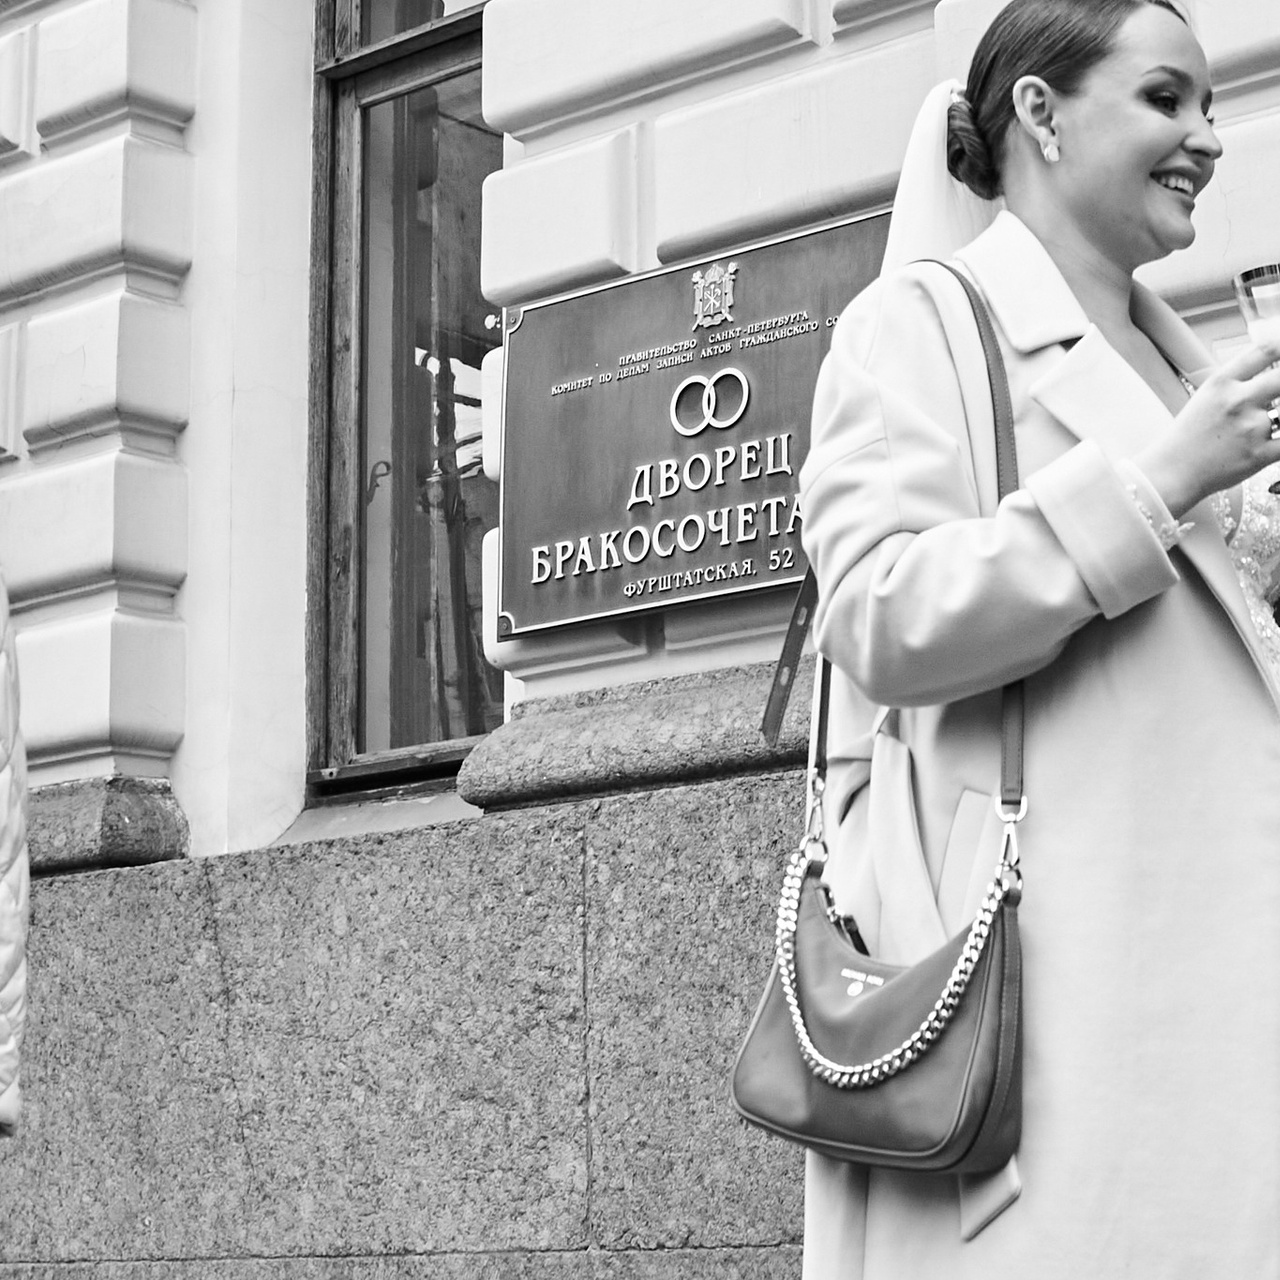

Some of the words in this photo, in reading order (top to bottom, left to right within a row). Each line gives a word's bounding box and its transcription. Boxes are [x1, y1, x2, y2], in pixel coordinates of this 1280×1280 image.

[551, 376, 593, 396] КОМИТЕТ
[599, 372, 612, 384] ПО
[616, 363, 650, 381] ДЕЛАМ
[656, 353, 694, 370] ЗАПИСИ
[700, 342, 732, 359] АКТОВ
[739, 322, 819, 349] ГРАЖДАНСКОГО
[619, 338, 697, 366] ПРАВИТЕЛЬСТВО
[627, 433, 794, 511] ДВОРЕЦ
[768, 547, 795, 571] 52
